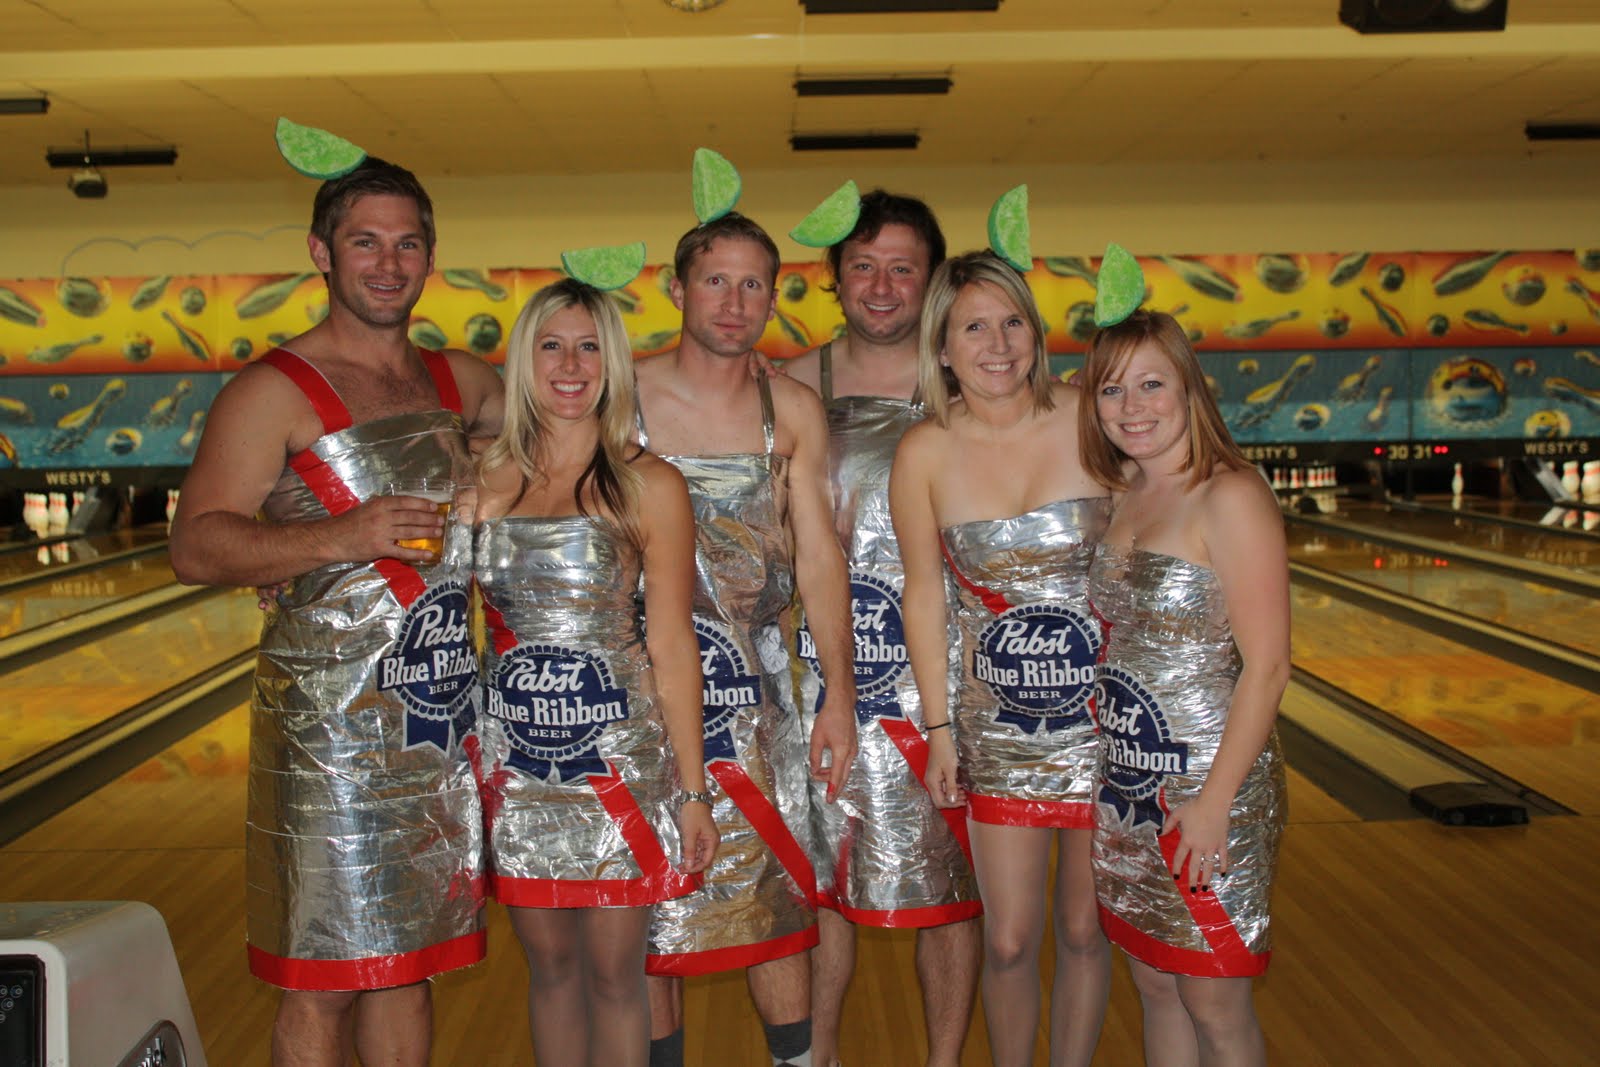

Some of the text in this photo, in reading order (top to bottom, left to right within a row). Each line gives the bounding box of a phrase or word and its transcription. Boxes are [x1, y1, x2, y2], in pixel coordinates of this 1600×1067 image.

[1388, 444, 1408, 460] 30
[1525, 441, 1588, 455] WESTY'S
[46, 471, 111, 486] WESTY'S
[854, 635, 910, 663] ibbo
[996, 619, 1072, 656] Pabst
[381, 646, 479, 689] Blue Ribbo
[505, 657, 587, 692] Pabst
[854, 666, 874, 675] ER
[975, 651, 1097, 688] Blue Ribbo
[428, 680, 459, 695] BEER
[1018, 690, 1062, 699] BEER
[487, 688, 625, 727] Blue Ribbon
[1095, 682, 1143, 736] Pabst
[528, 728, 573, 739] BEER
[1105, 733, 1182, 773] Ribbon
